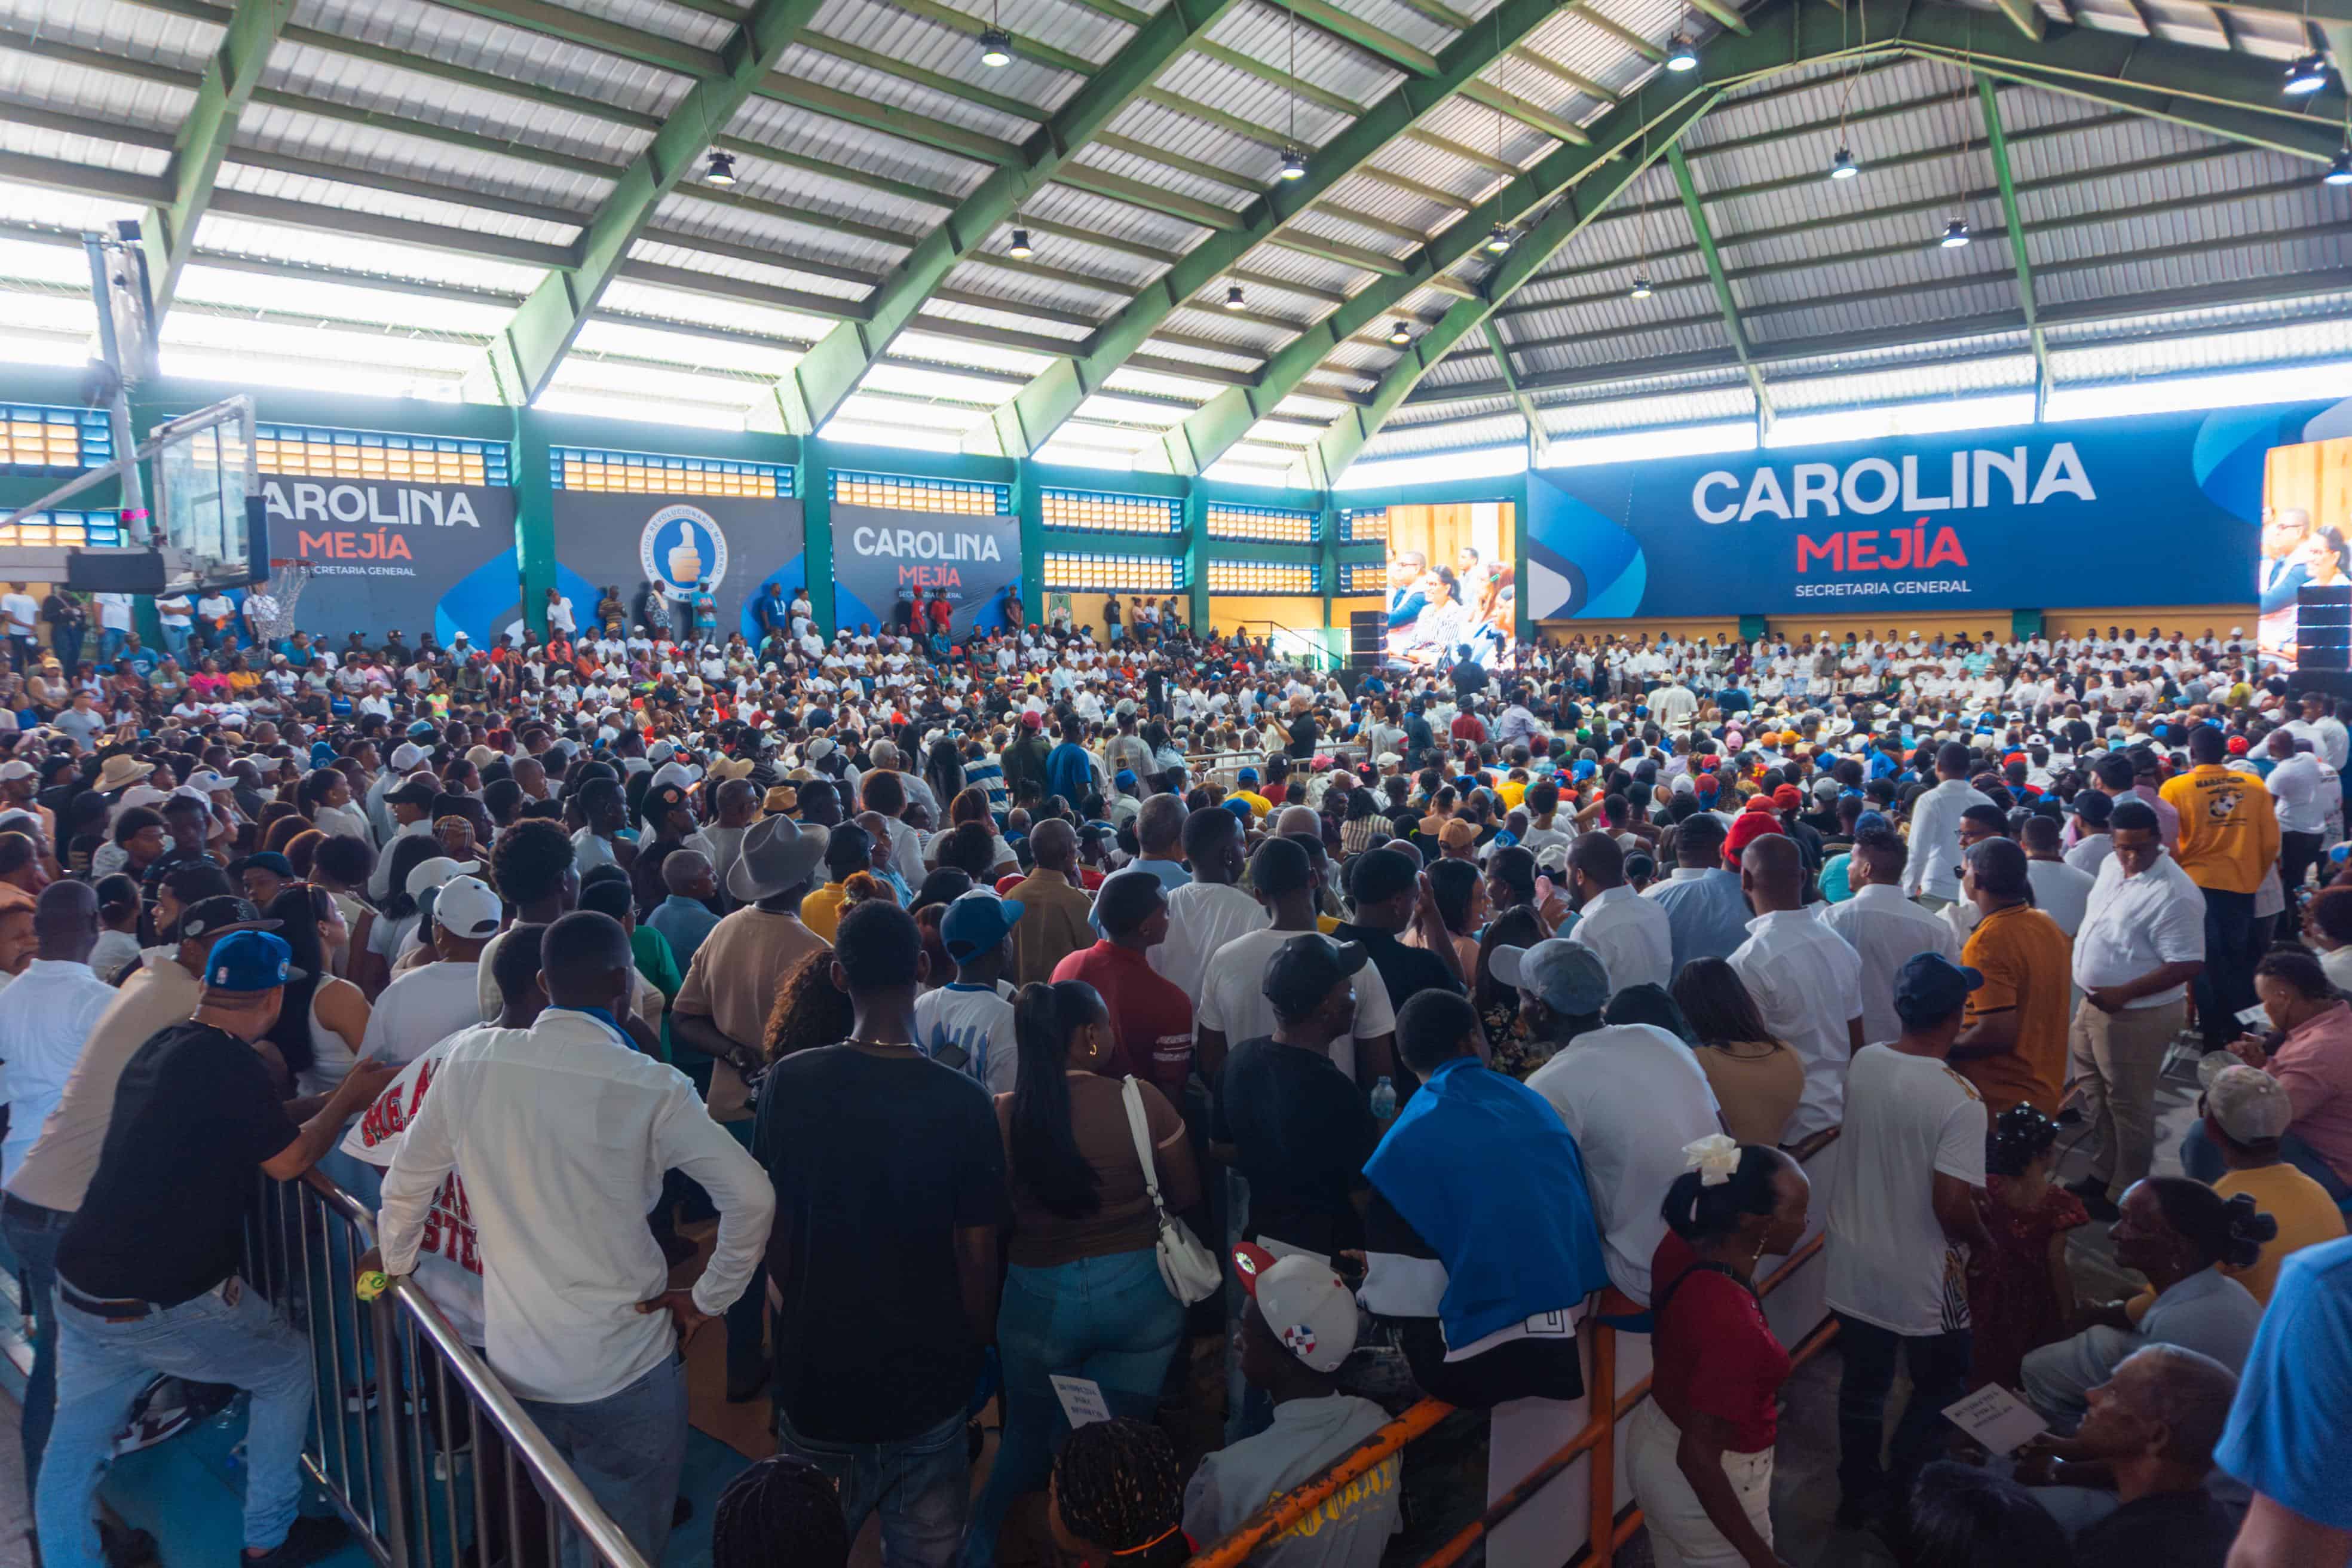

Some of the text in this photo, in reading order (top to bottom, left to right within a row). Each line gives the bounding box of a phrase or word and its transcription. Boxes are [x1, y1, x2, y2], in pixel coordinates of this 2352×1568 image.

[1692, 442, 2097, 524] CAROLINA
[261, 481, 480, 528] AROLINA
[299, 526, 413, 560] MEJÍA
[853, 526, 1001, 562] CAROLINA
[1796, 517, 1968, 573] MEJÍA
[368, 566, 416, 576] GENERAL
[898, 562, 961, 587] MEJÍA
[1796, 580, 1972, 598] SECRETARIA GENERAL
